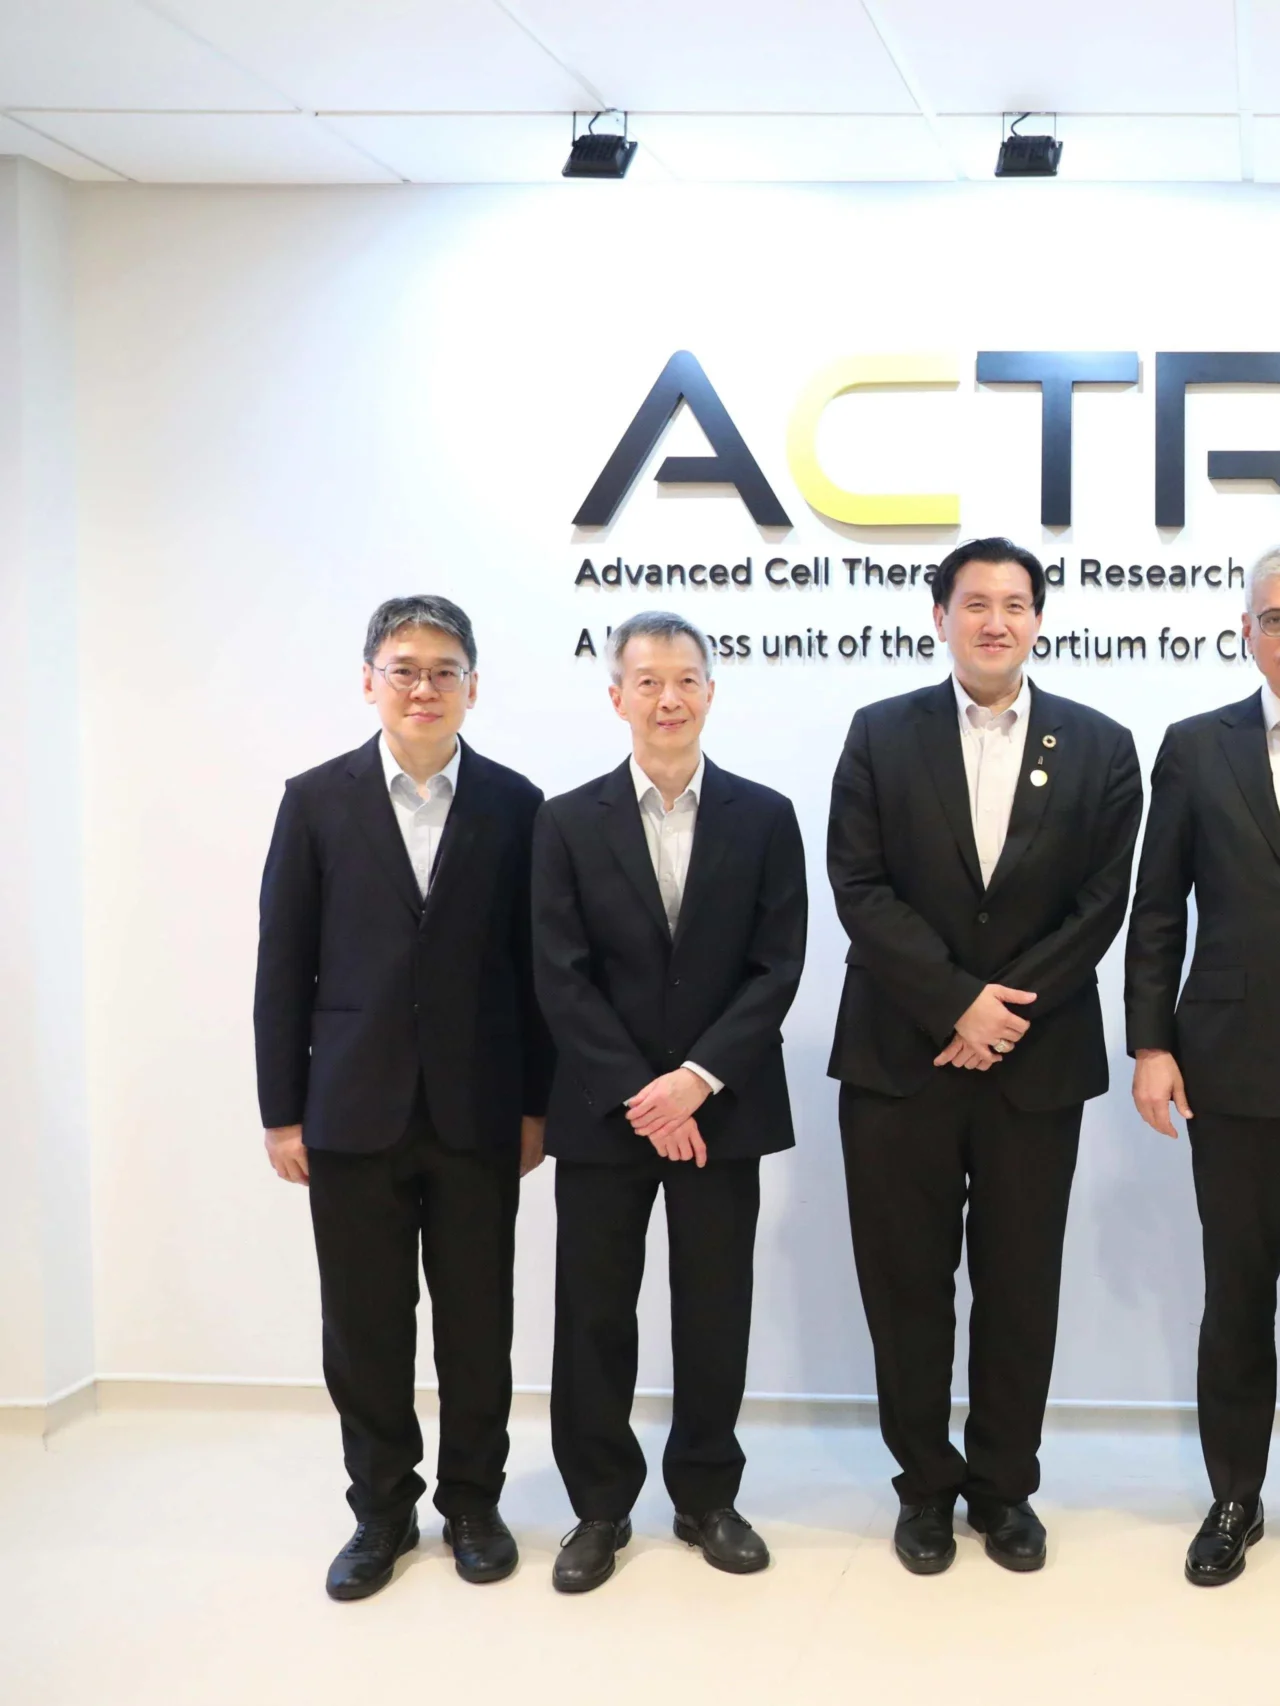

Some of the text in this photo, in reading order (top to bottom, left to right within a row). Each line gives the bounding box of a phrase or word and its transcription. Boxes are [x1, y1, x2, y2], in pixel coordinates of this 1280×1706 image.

[574, 556, 752, 586] Advanced
[764, 556, 829, 586] Cell
[842, 556, 940, 586] Thera
[1080, 557, 1245, 588] Research
[574, 628, 597, 657] A
[762, 627, 829, 658] unit
[838, 625, 872, 658] of
[879, 626, 935, 658] the
[1033, 627, 1146, 660] ortium
[1158, 626, 1206, 660] for
